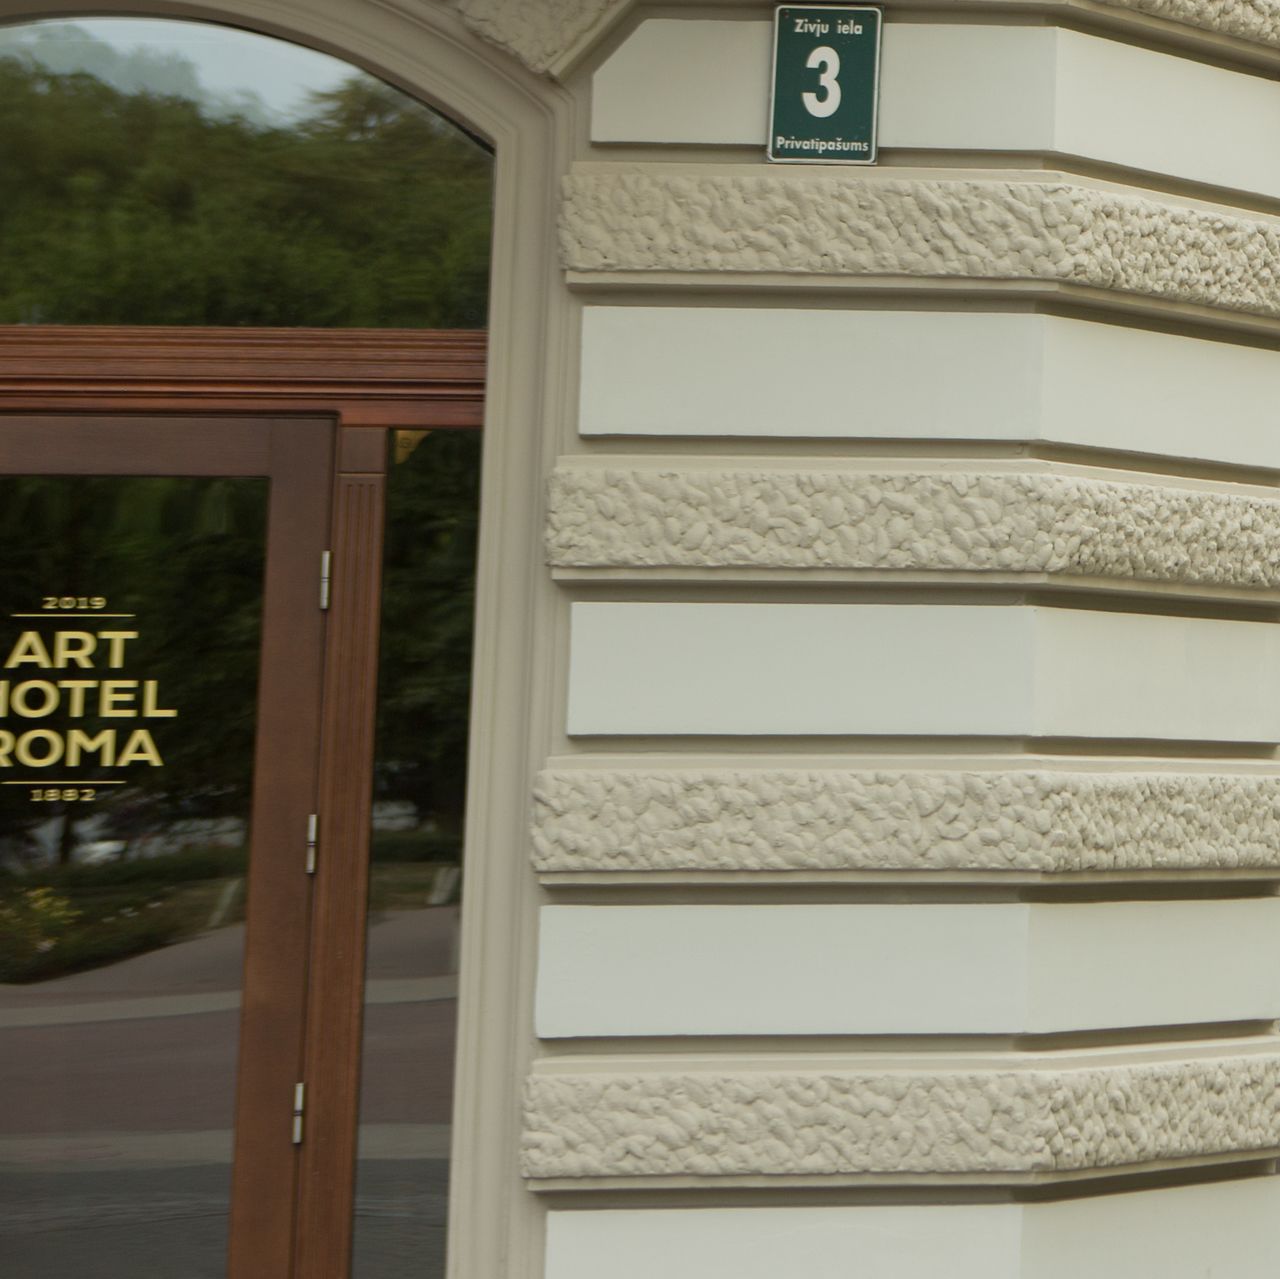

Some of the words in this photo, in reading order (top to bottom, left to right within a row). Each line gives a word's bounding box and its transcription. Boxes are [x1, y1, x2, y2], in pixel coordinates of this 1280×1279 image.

[794, 19, 829, 37] Zivju
[837, 20, 862, 35] iela
[802, 46, 842, 118] 3
[41, 597, 107, 609] 2019
[4, 631, 139, 668] ART
[0, 680, 178, 718] OTEL
[29, 788, 96, 802] 1882
